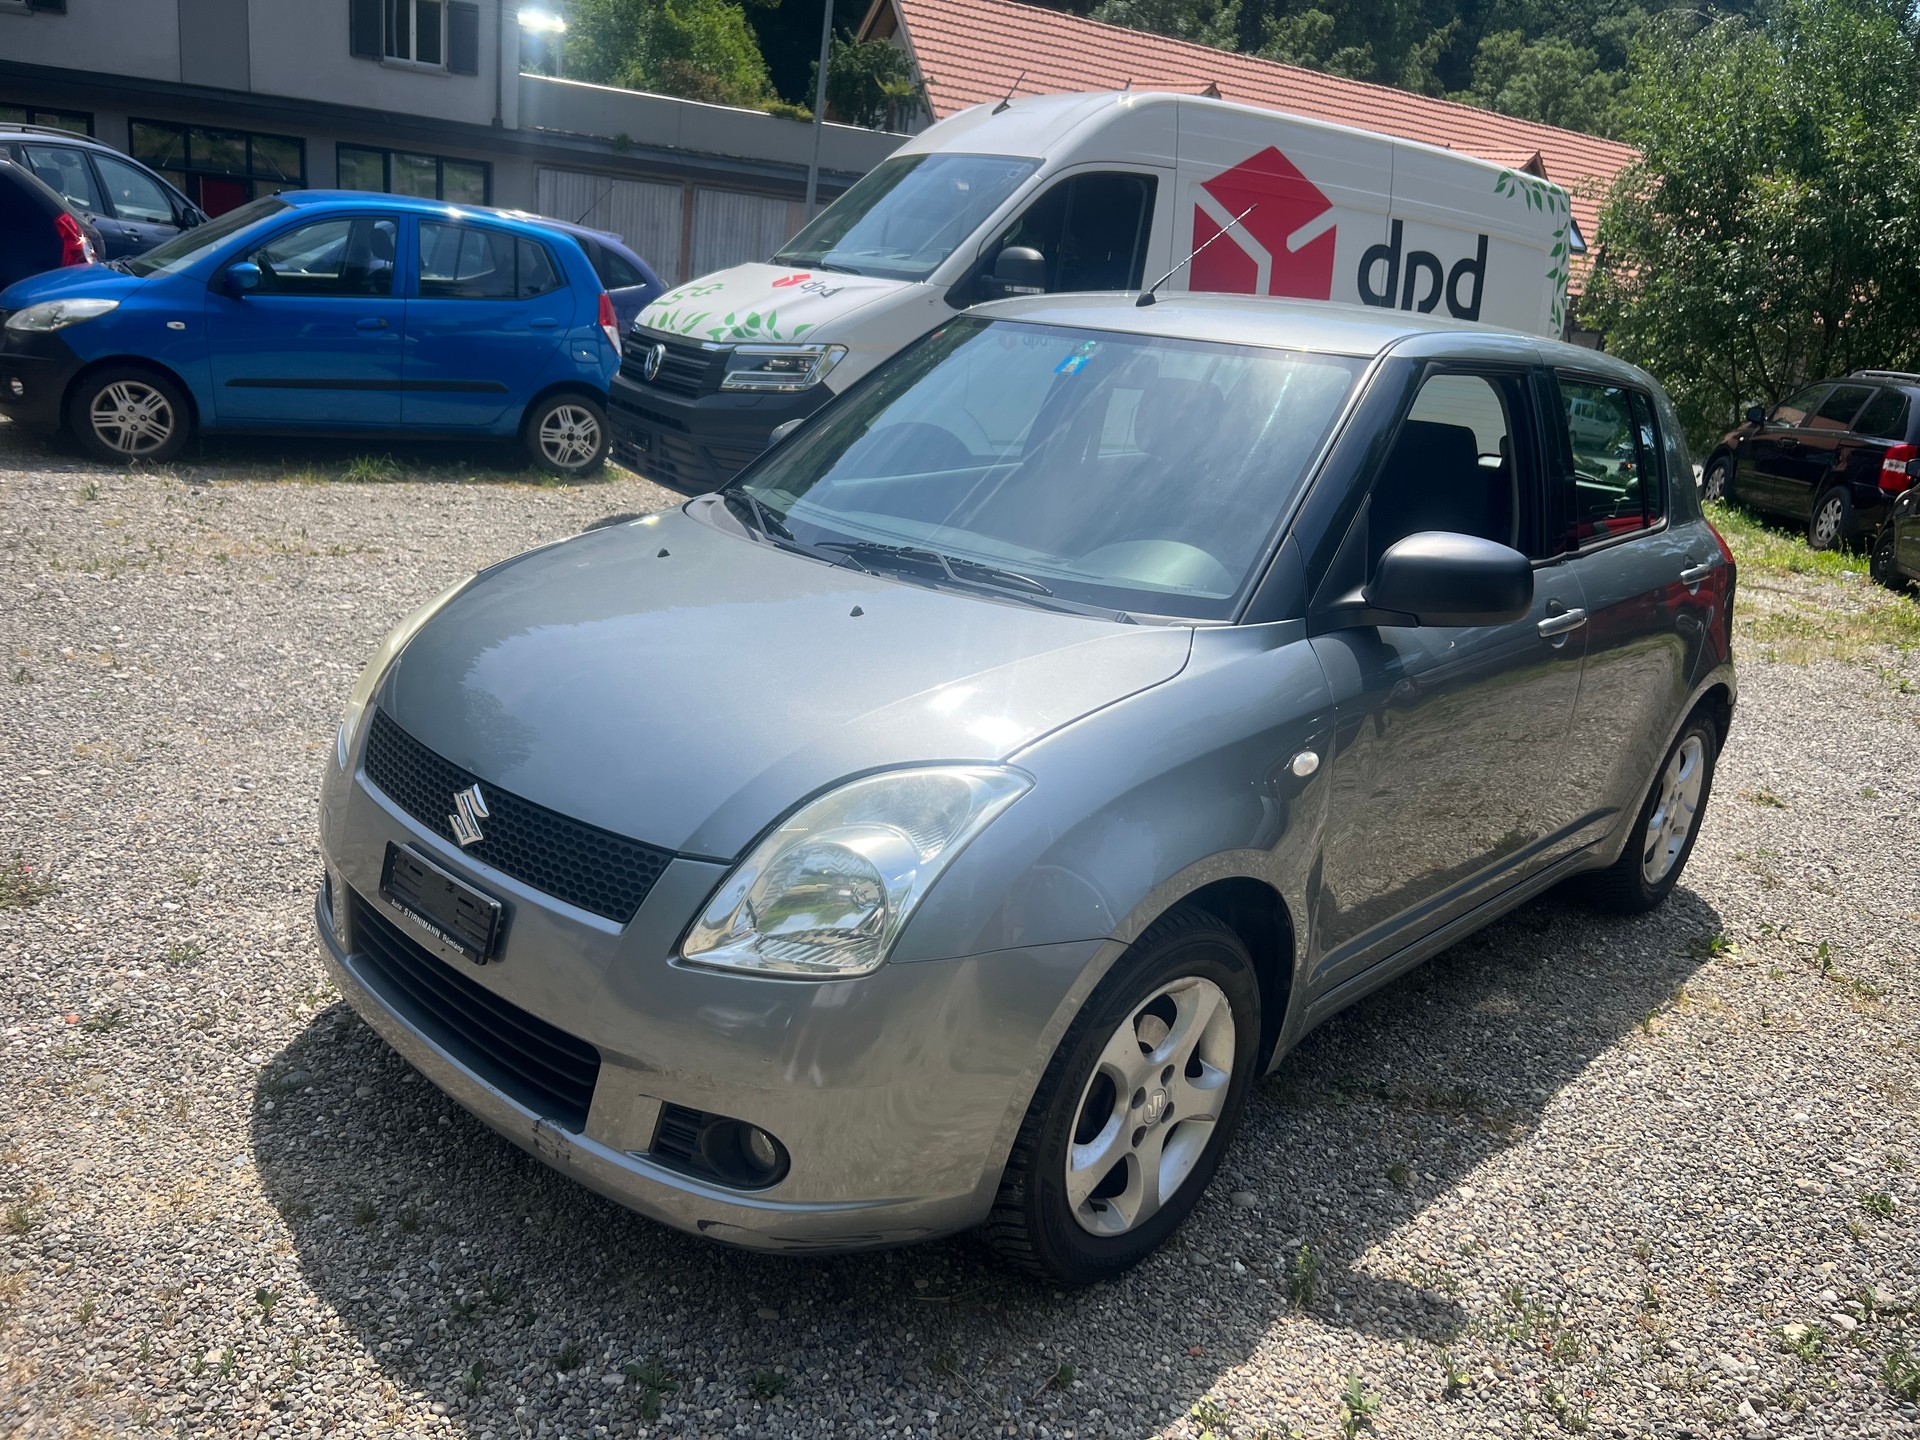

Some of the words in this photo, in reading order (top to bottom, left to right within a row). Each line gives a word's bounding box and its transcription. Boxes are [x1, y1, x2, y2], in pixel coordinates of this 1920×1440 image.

[1358, 219, 1488, 321] dpd
[800, 281, 846, 298] dpd
[404, 907, 440, 938] STIRNIMANN
